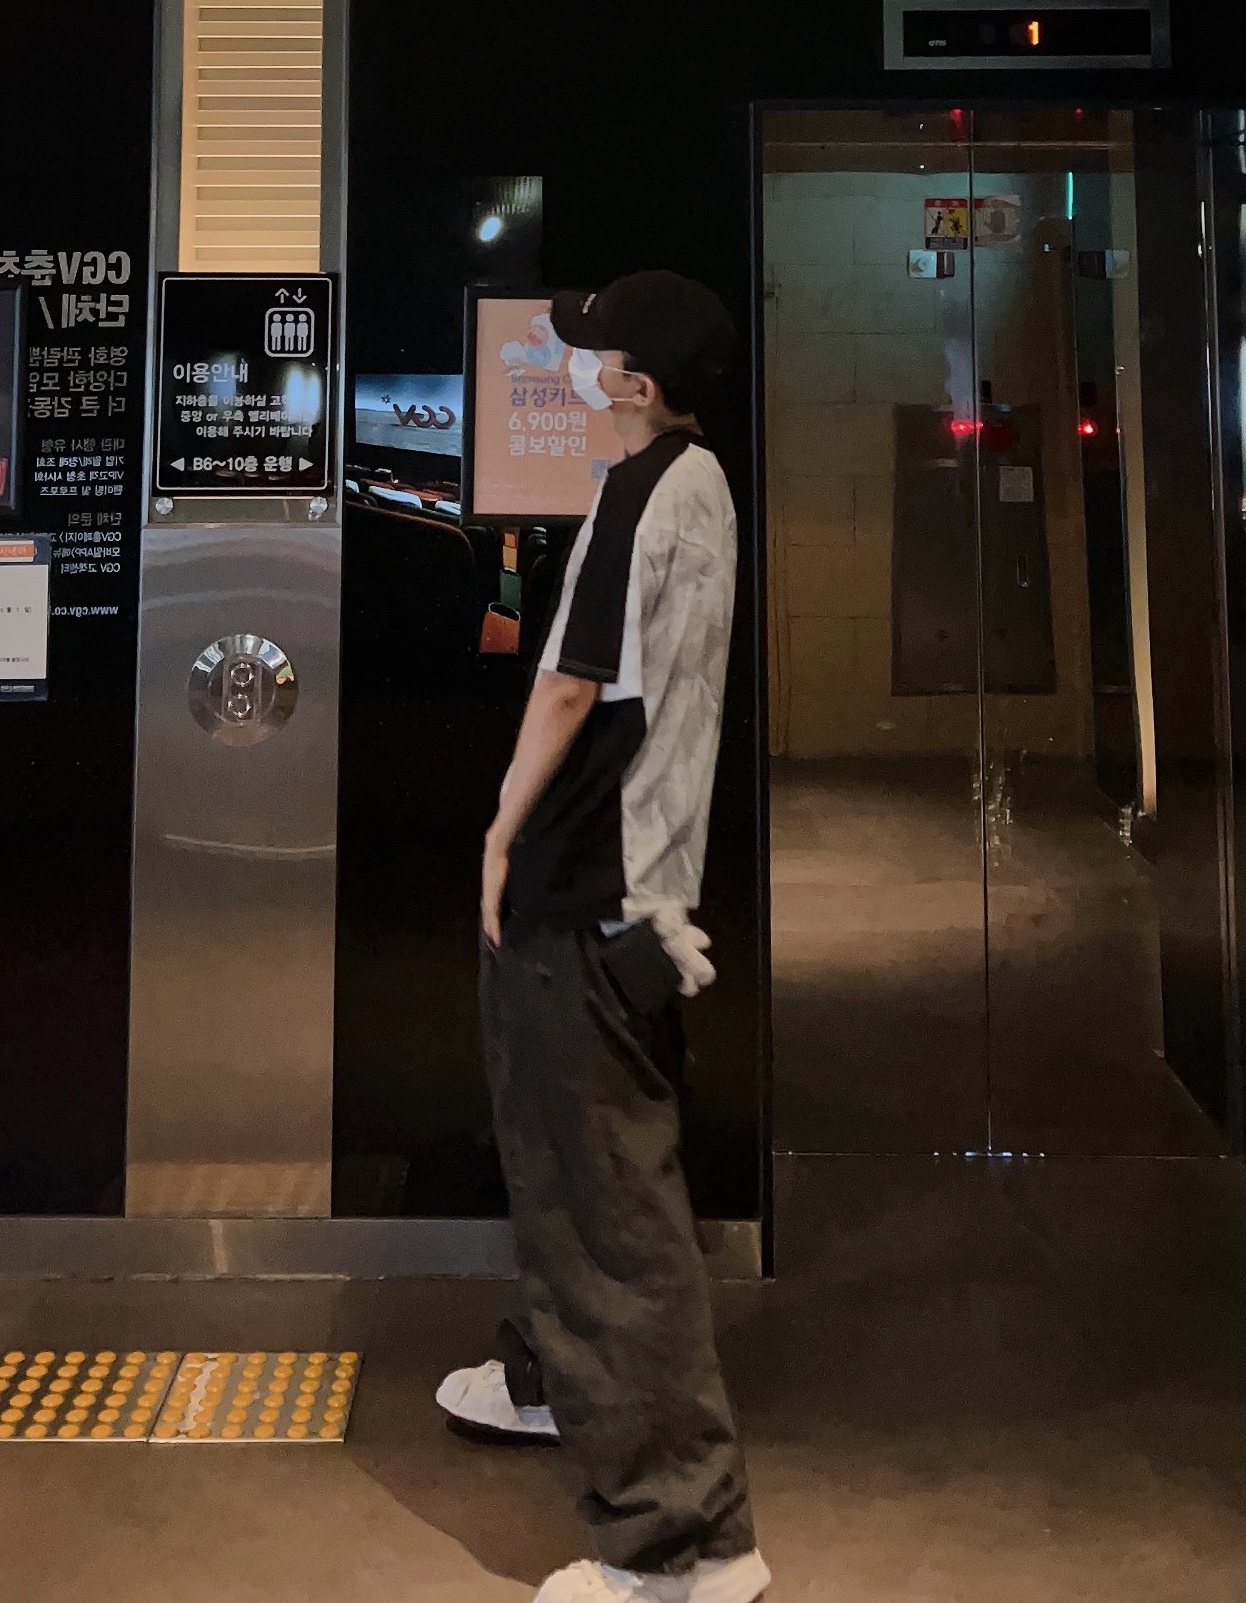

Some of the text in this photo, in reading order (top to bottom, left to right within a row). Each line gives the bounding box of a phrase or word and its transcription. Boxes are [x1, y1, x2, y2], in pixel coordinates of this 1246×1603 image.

[1028, 20, 1040, 46] 1
[173, 362, 249, 384] 이용안내
[175, 395, 218, 407] 지하층을
[223, 395, 267, 407] 이용하실
[180, 410, 203, 423] 중앙
[206, 413, 219, 422] or
[222, 410, 244, 423] 우측
[196, 426, 313, 438] 이용해 주시기 바랍니다
[508, 435, 587, 457] 콤보할인
[193, 455, 293, 472] B6~10층 운행
